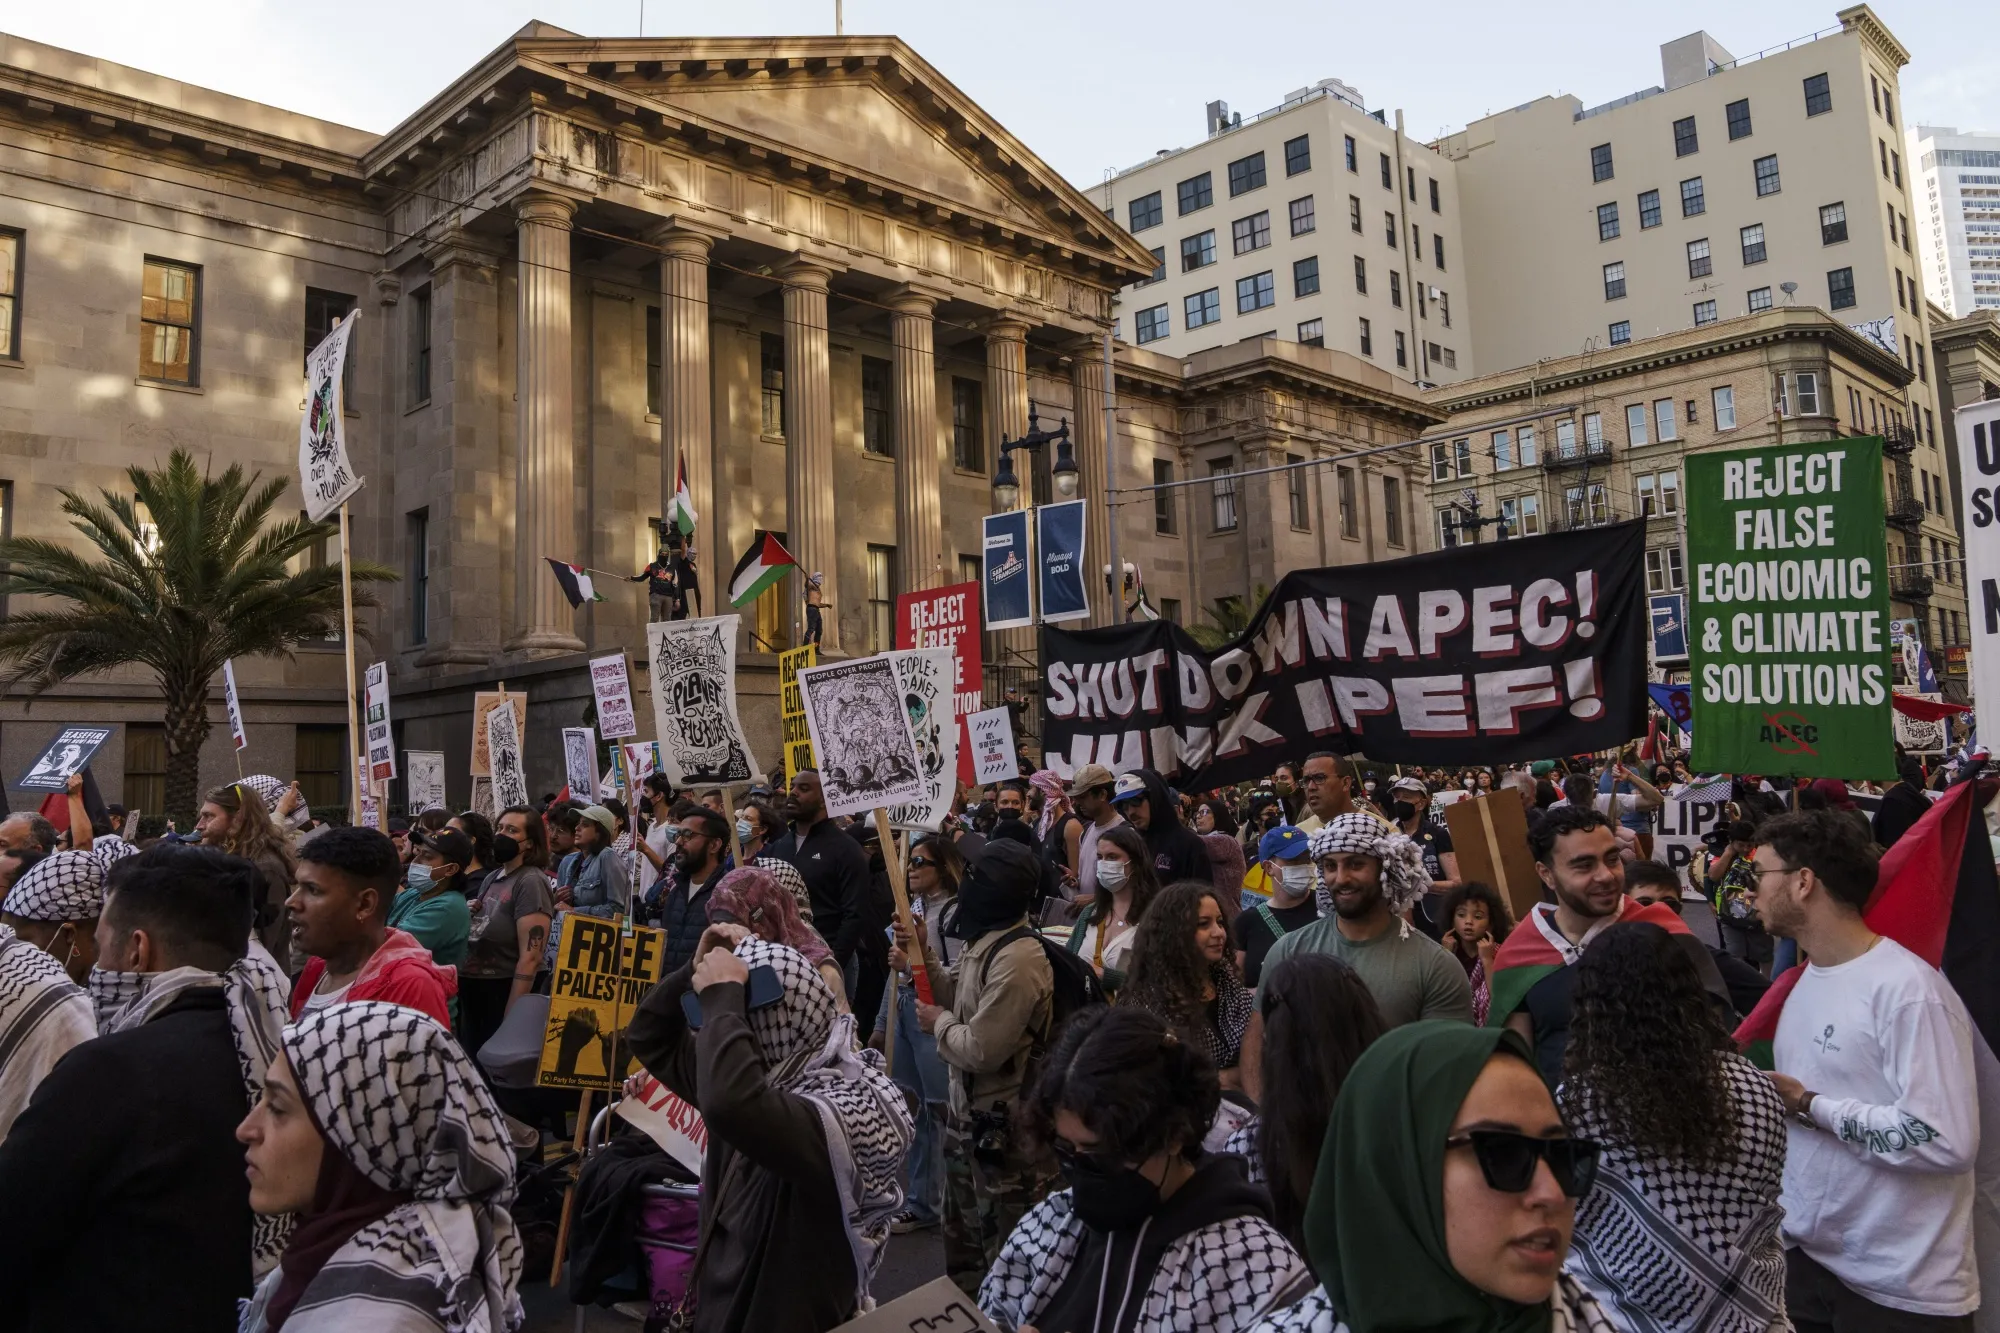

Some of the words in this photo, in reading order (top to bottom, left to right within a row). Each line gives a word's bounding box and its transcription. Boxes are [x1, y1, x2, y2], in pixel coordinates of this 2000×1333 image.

[311, 464, 325, 481] OVER
[1723, 451, 1846, 500] REJECT
[1735, 505, 1834, 550] FALSE
[988, 537, 1005, 546] Welcome
[995, 562, 1022, 581] FRANCISCO
[1047, 552, 1073, 564] Always
[1051, 564, 1070, 574] BOLD
[992, 567, 1003, 577] SAN
[1698, 557, 1872, 603] ECONOMIC
[910, 593, 965, 631] REJECT
[1702, 617, 1722, 653] &
[1731, 611, 1882, 653] CLIMATE
[1047, 648, 1167, 722] SHUT
[1177, 597, 1349, 711] DOWN
[1364, 570, 1597, 660] APEC!
[670, 657, 708, 674] PEOPLE
[783, 649, 809, 684] REJECT
[807, 671, 835, 682] PEOPLE
[836, 666, 857, 676] OVER
[858, 660, 889, 672] PROFITS
[673, 672, 721, 714] PLANET
[1702, 664, 1885, 706] SOLUTIONS
[684, 704, 716, 718] OVER
[1046, 691, 1286, 780] JUNK
[1296, 656, 1602, 736] IPEF!
[675, 713, 727, 749] PLUNDER
[1759, 723, 1819, 744] APEC
[793, 744, 812, 771] OUR
[728, 769, 748, 778] 2023
[832, 796, 860, 808] PLANET
[862, 791, 883, 801] OVER
[885, 783, 920, 797] PLUNDER
[568, 920, 656, 980] FREE
